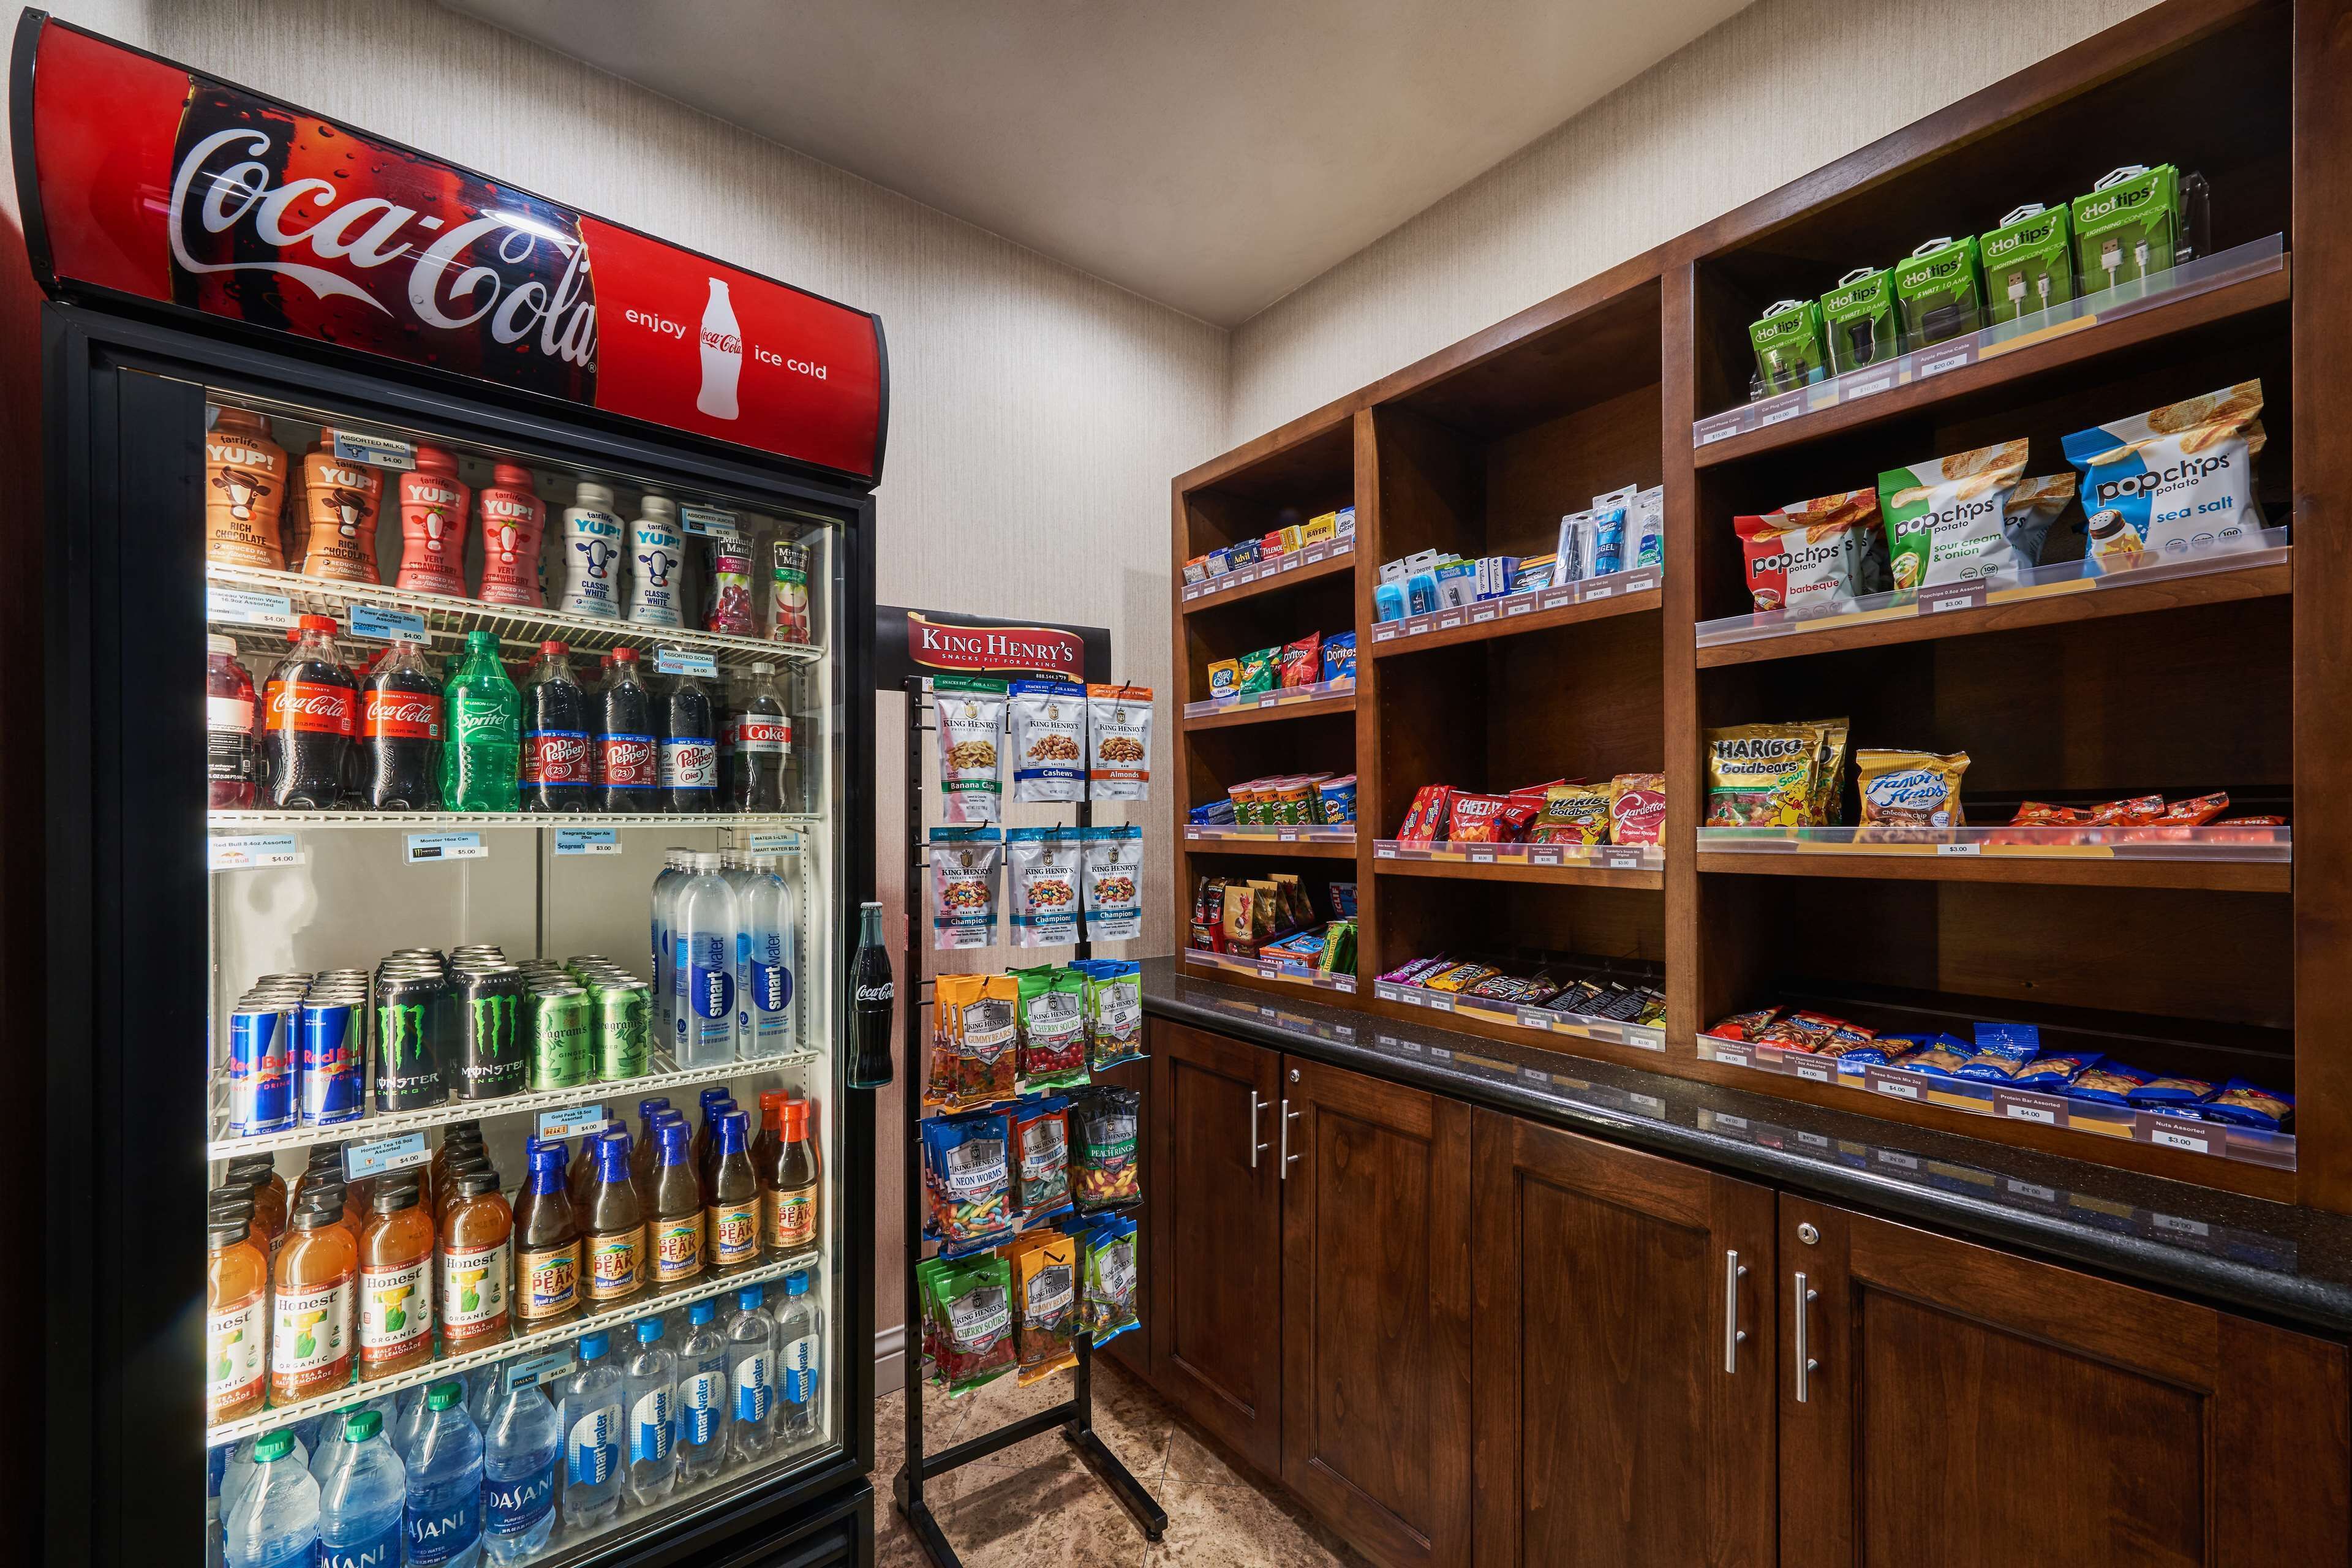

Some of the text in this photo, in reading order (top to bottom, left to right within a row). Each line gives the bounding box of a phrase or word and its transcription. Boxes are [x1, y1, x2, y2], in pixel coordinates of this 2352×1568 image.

[169, 128, 598, 368] Coca-Cola
[1921, 286, 1939, 297] WATT
[1952, 275, 1969, 287] AMP
[625, 309, 687, 340] enjoy
[701, 327, 742, 355] Coca-Cola
[1936, 349, 1953, 358] Phone
[1954, 343, 1970, 353] Cable
[755, 344, 827, 380] ice cold
[1934, 360, 1954, 370] $20.00
[1780, 396, 1800, 408] Universal
[1773, 411, 1789, 420] $10.00
[340, 434, 405, 451] ASSORTED MILKS
[207, 443, 274, 471] YUP!
[382, 455, 402, 465] $4.00
[2095, 453, 2230, 508] popchips
[2155, 478, 2199, 497] potato
[2157, 496, 2234, 524] sea salt
[687, 512, 734, 525] ASSORTED JUICES
[230, 521, 252, 533] RICH
[1306, 526, 1327, 538] BAYER
[216, 529, 266, 546] CHOCOLATE
[1934, 532, 2002, 553] sour cream
[778, 547, 808, 560] Minute
[1262, 545, 1283, 556] TYLENOL
[1933, 546, 1980, 562] & onion
[783, 555, 806, 567] Maid
[1234, 552, 1250, 564] Advil
[1789, 578, 1839, 595] barbeque
[1920, 590, 1943, 600] Popchips
[1959, 584, 1985, 594] Assorted
[644, 590, 670, 600] CLASSIC
[647, 597, 667, 607] WHITE
[1945, 598, 1963, 608] $3.00
[360, 609, 387, 619] Powerade
[375, 616, 402, 624] Assorted
[922, 628, 1073, 662] KING HENRY'S
[663, 651, 693, 660] ASSORTED
[942, 653, 979, 662] SNACKS
[273, 692, 348, 717] Coca-Cola
[461, 713, 504, 728] Sprite
[748, 726, 785, 741] Coke
[558, 739, 573, 752] Dr
[1717, 739, 1803, 760] HARIBO
[543, 745, 582, 763] Pepper
[1720, 761, 1798, 775] Goldbears
[685, 772, 699, 780] Diet
[1779, 769, 1808, 788] Sour
[951, 782, 995, 791] Banana Chips
[1865, 771, 1944, 796] Famous
[1880, 786, 1948, 807] Amos
[1327, 812, 1345, 824] Pringles
[1035, 914, 1071, 924] Champions
[1034, 1019, 1079, 1033] CHERRY SOURS
[968, 1028, 1012, 1044] GUMMY BEARS
[559, 1049, 586, 1058] GINGER
[461, 1060, 524, 1079] MONSTER
[1887, 1072, 1903, 1081] Snack
[470, 1073, 519, 1084] ENERGY
[2000, 1094, 2021, 1102] Protein
[2034, 1099, 2060, 1108] Assorted
[2021, 1109, 2040, 1118] $4.00
[2155, 1120, 2205, 1134] Nuts Assorted
[2168, 1135, 2191, 1146] $3.00
[361, 1144, 382, 1153] Honest
[374, 1145, 401, 1155] Assorted
[1091, 1143, 1134, 1157] PEACH RINGS
[956, 1167, 1002, 1186] NEON WORMS
[718, 1218, 754, 1229] GOLD
[718, 1224, 754, 1240] PEAK
[367, 1267, 423, 1289] Honest
[371, 1328, 417, 1343] ORGANIC
[489, 1471, 552, 1512] DASANI
